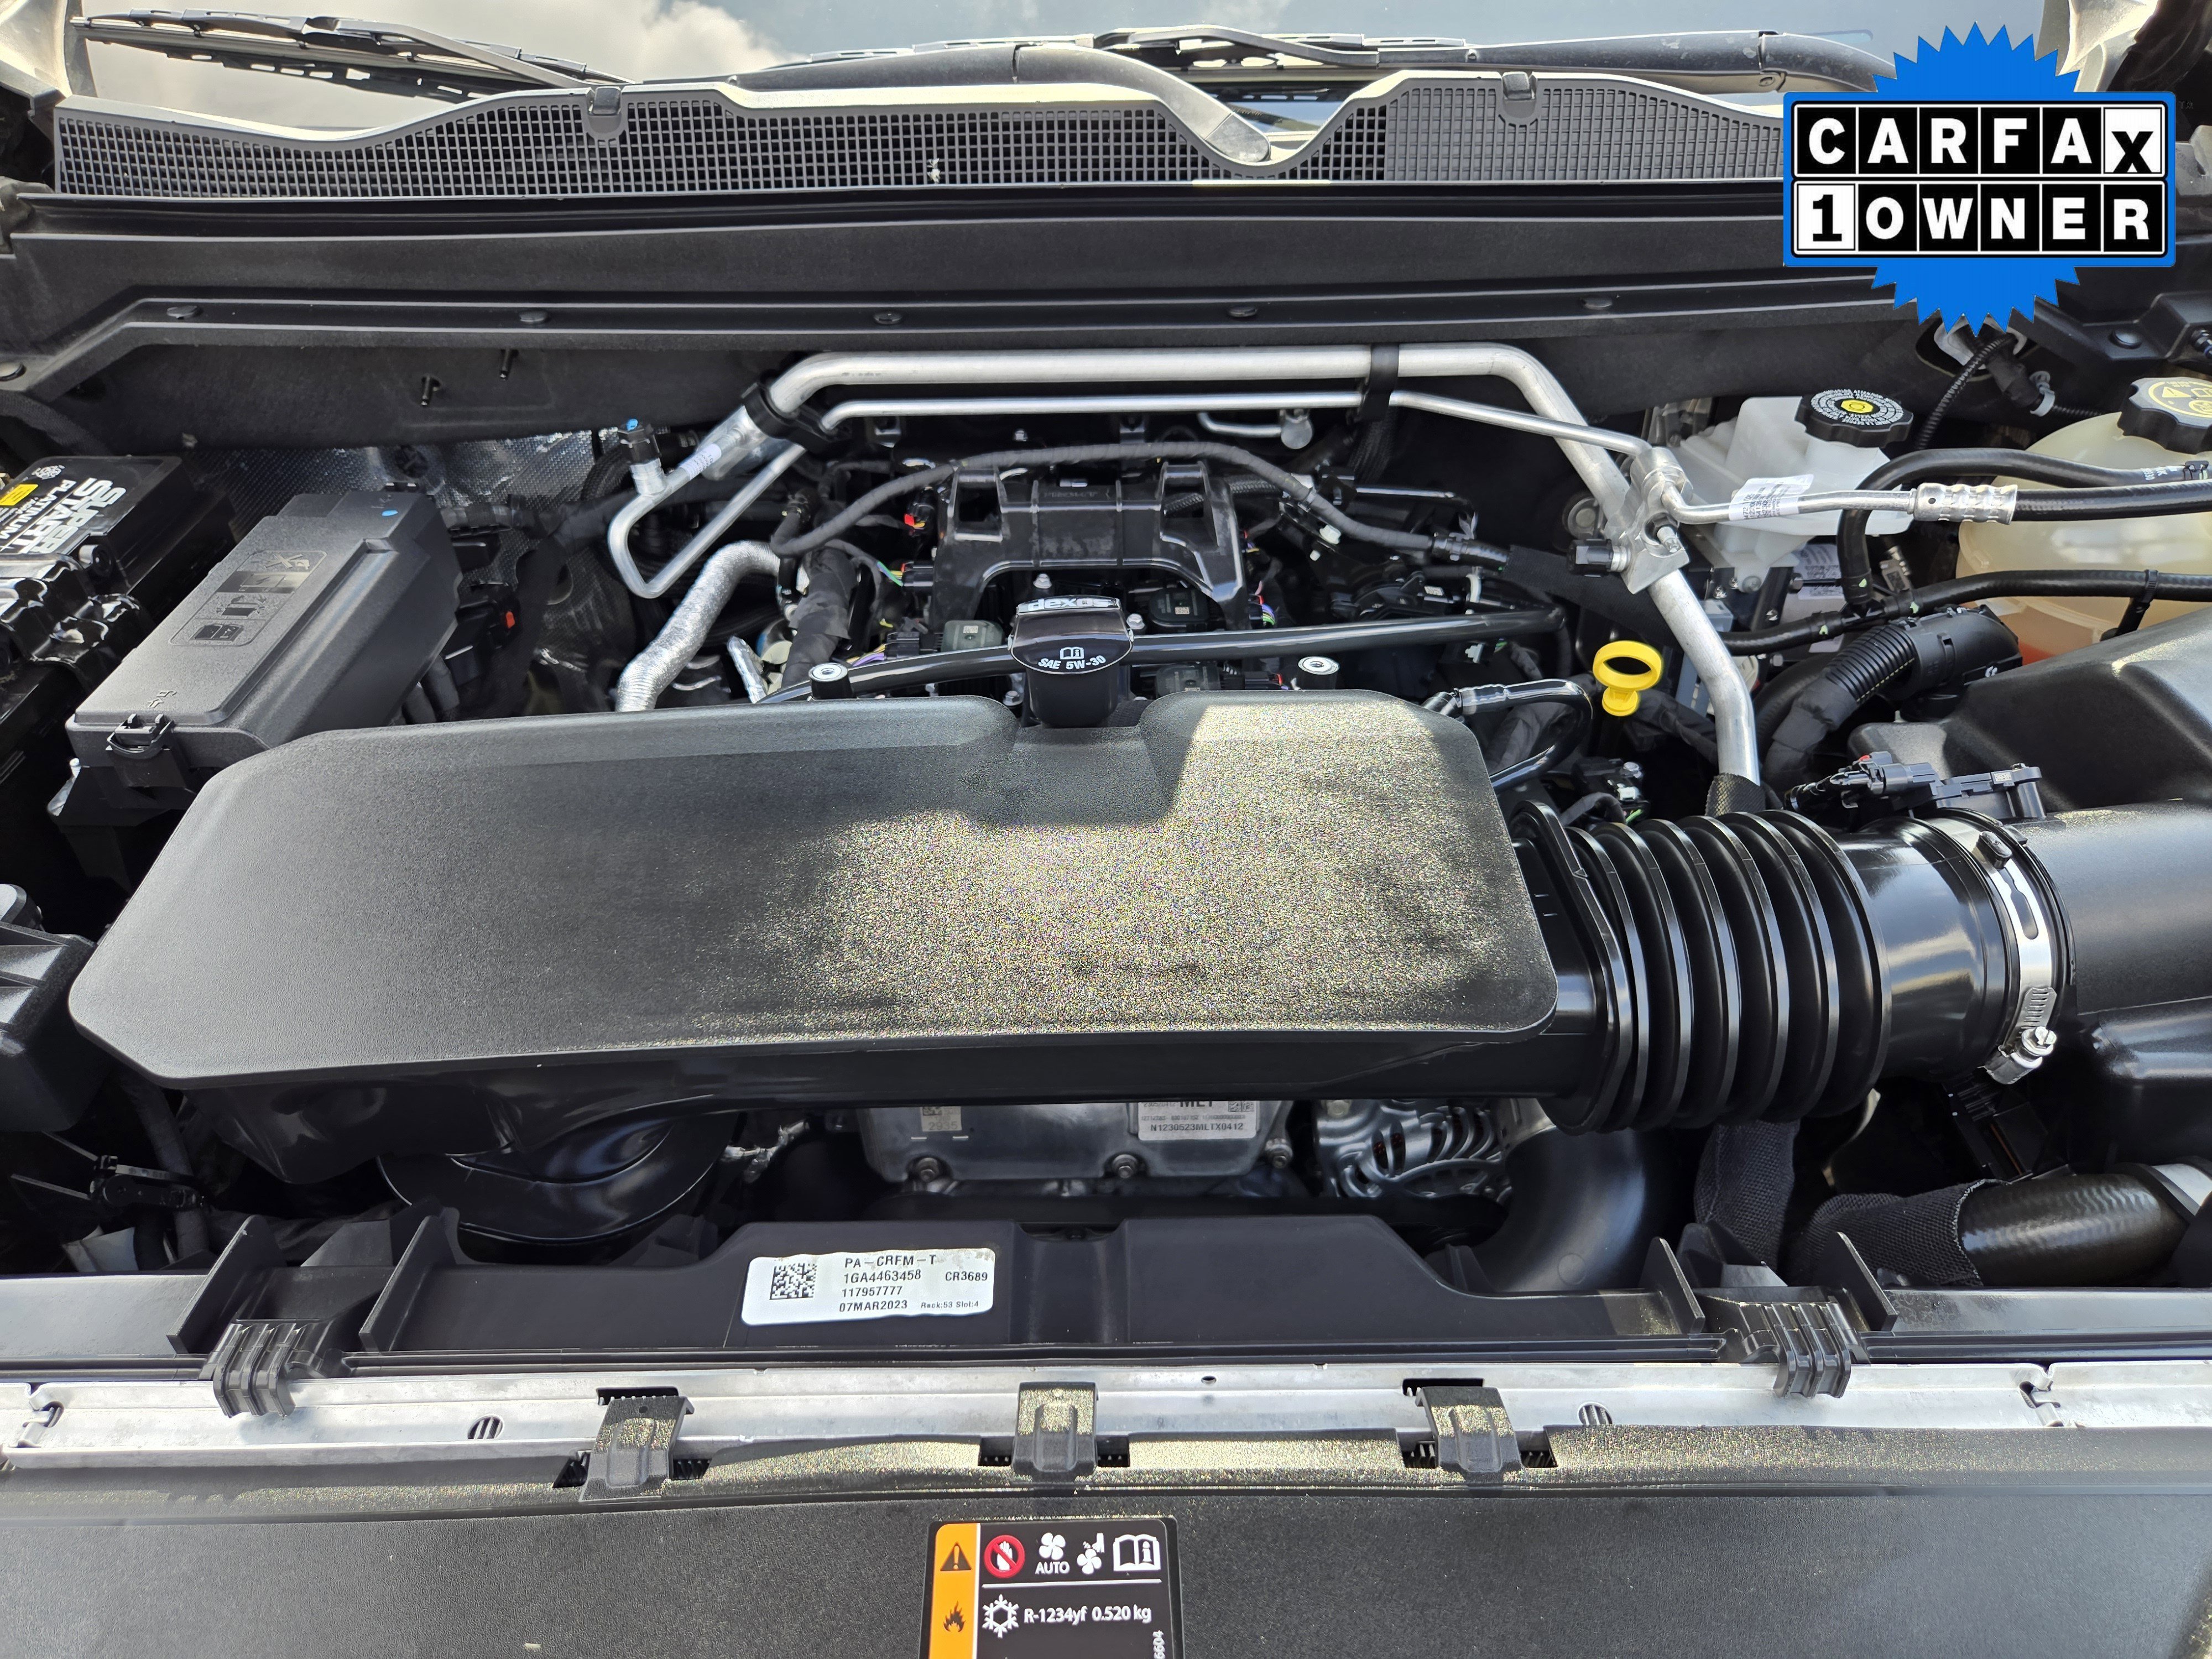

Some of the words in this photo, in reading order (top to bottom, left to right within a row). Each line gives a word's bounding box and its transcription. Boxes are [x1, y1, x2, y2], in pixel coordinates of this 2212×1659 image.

[0, 479, 76, 540] PLATINUM
[12, 478, 113, 554] START
[29, 487, 126, 553] SUPER
[1027, 598, 1109, 611] dexos
[1038, 658, 1061, 669] SAE
[1066, 655, 1106, 670] 5W-30
[1150, 1123, 1243, 1131] N1230523MLTX0412
[844, 1269, 921, 1284] 1GA4463458
[945, 1271, 988, 1281] CR3689
[842, 1286, 903, 1297] 117957777
[839, 1300, 908, 1312] 07MAR2023
[1035, 1561, 1070, 1575] AUTO
[1024, 1606, 1088, 1625] R-1234yf
[1092, 1606, 1130, 1621] 0.520
[1133, 1605, 1152, 1624] kg
